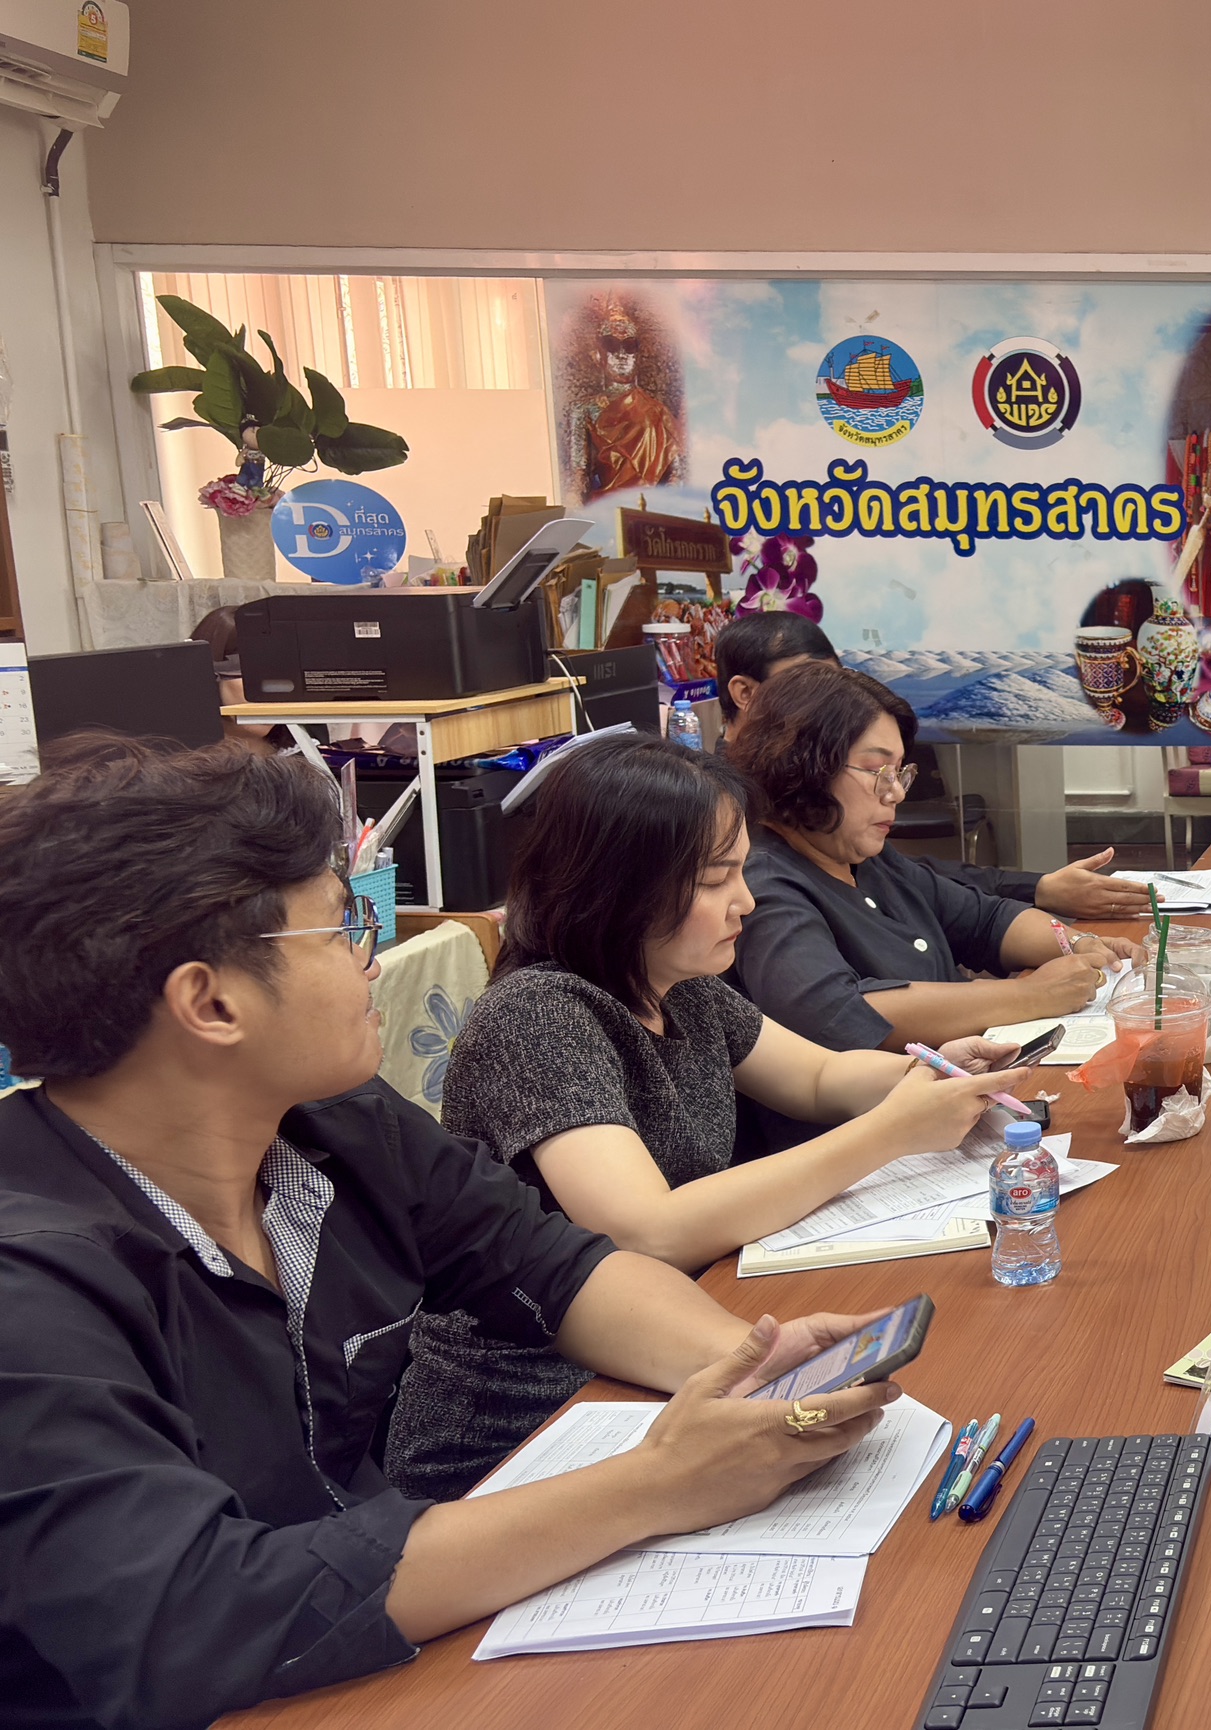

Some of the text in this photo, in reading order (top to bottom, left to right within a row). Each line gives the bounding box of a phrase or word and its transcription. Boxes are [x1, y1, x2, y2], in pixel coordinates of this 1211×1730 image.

[838, 423, 908, 447] จังหวัดสมุทรสาคร
[354, 506, 389, 527] ที่สุด
[713, 461, 1183, 553] จังหวัดสมุทรสาคร
[338, 526, 405, 538] สมุทรสาคร
[1012, 1187, 1029, 1196] aro
[1101, 1633, 1112, 1652] backspace
[1094, 1685, 1102, 1696] home
